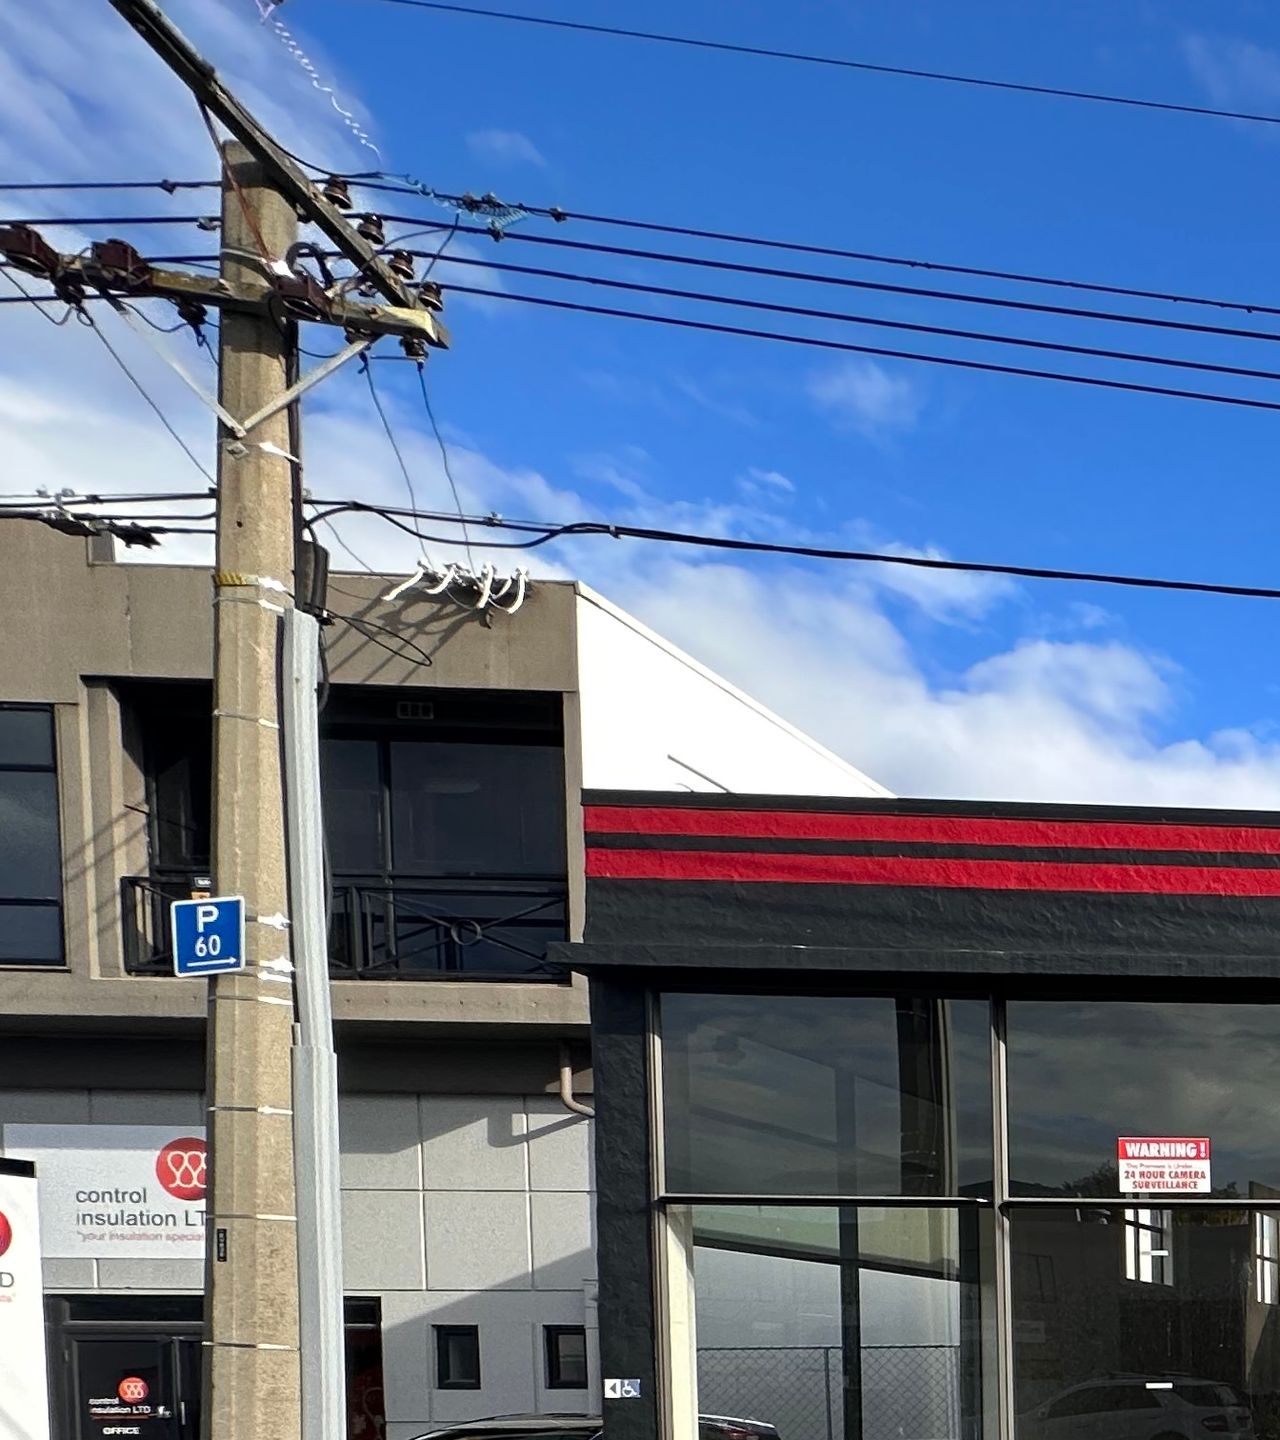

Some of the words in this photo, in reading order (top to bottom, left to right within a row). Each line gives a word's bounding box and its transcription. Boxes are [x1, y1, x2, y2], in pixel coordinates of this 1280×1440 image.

[196, 905, 219, 933] P
[195, 934, 221, 957] 60
[1125, 1142, 1197, 1158] WARNING
[1124, 1170, 1136, 1179] 24
[1139, 1170, 1166, 1180] HOUR
[1168, 1170, 1206, 1180] CAMERA
[1132, 1180, 1198, 1190] SURVEILLANCE
[76, 1187, 147, 1203] control
[76, 1210, 177, 1226] insulation
[184, 1210, 206, 1226] LT
[132, 1405, 151, 1414] LTD
